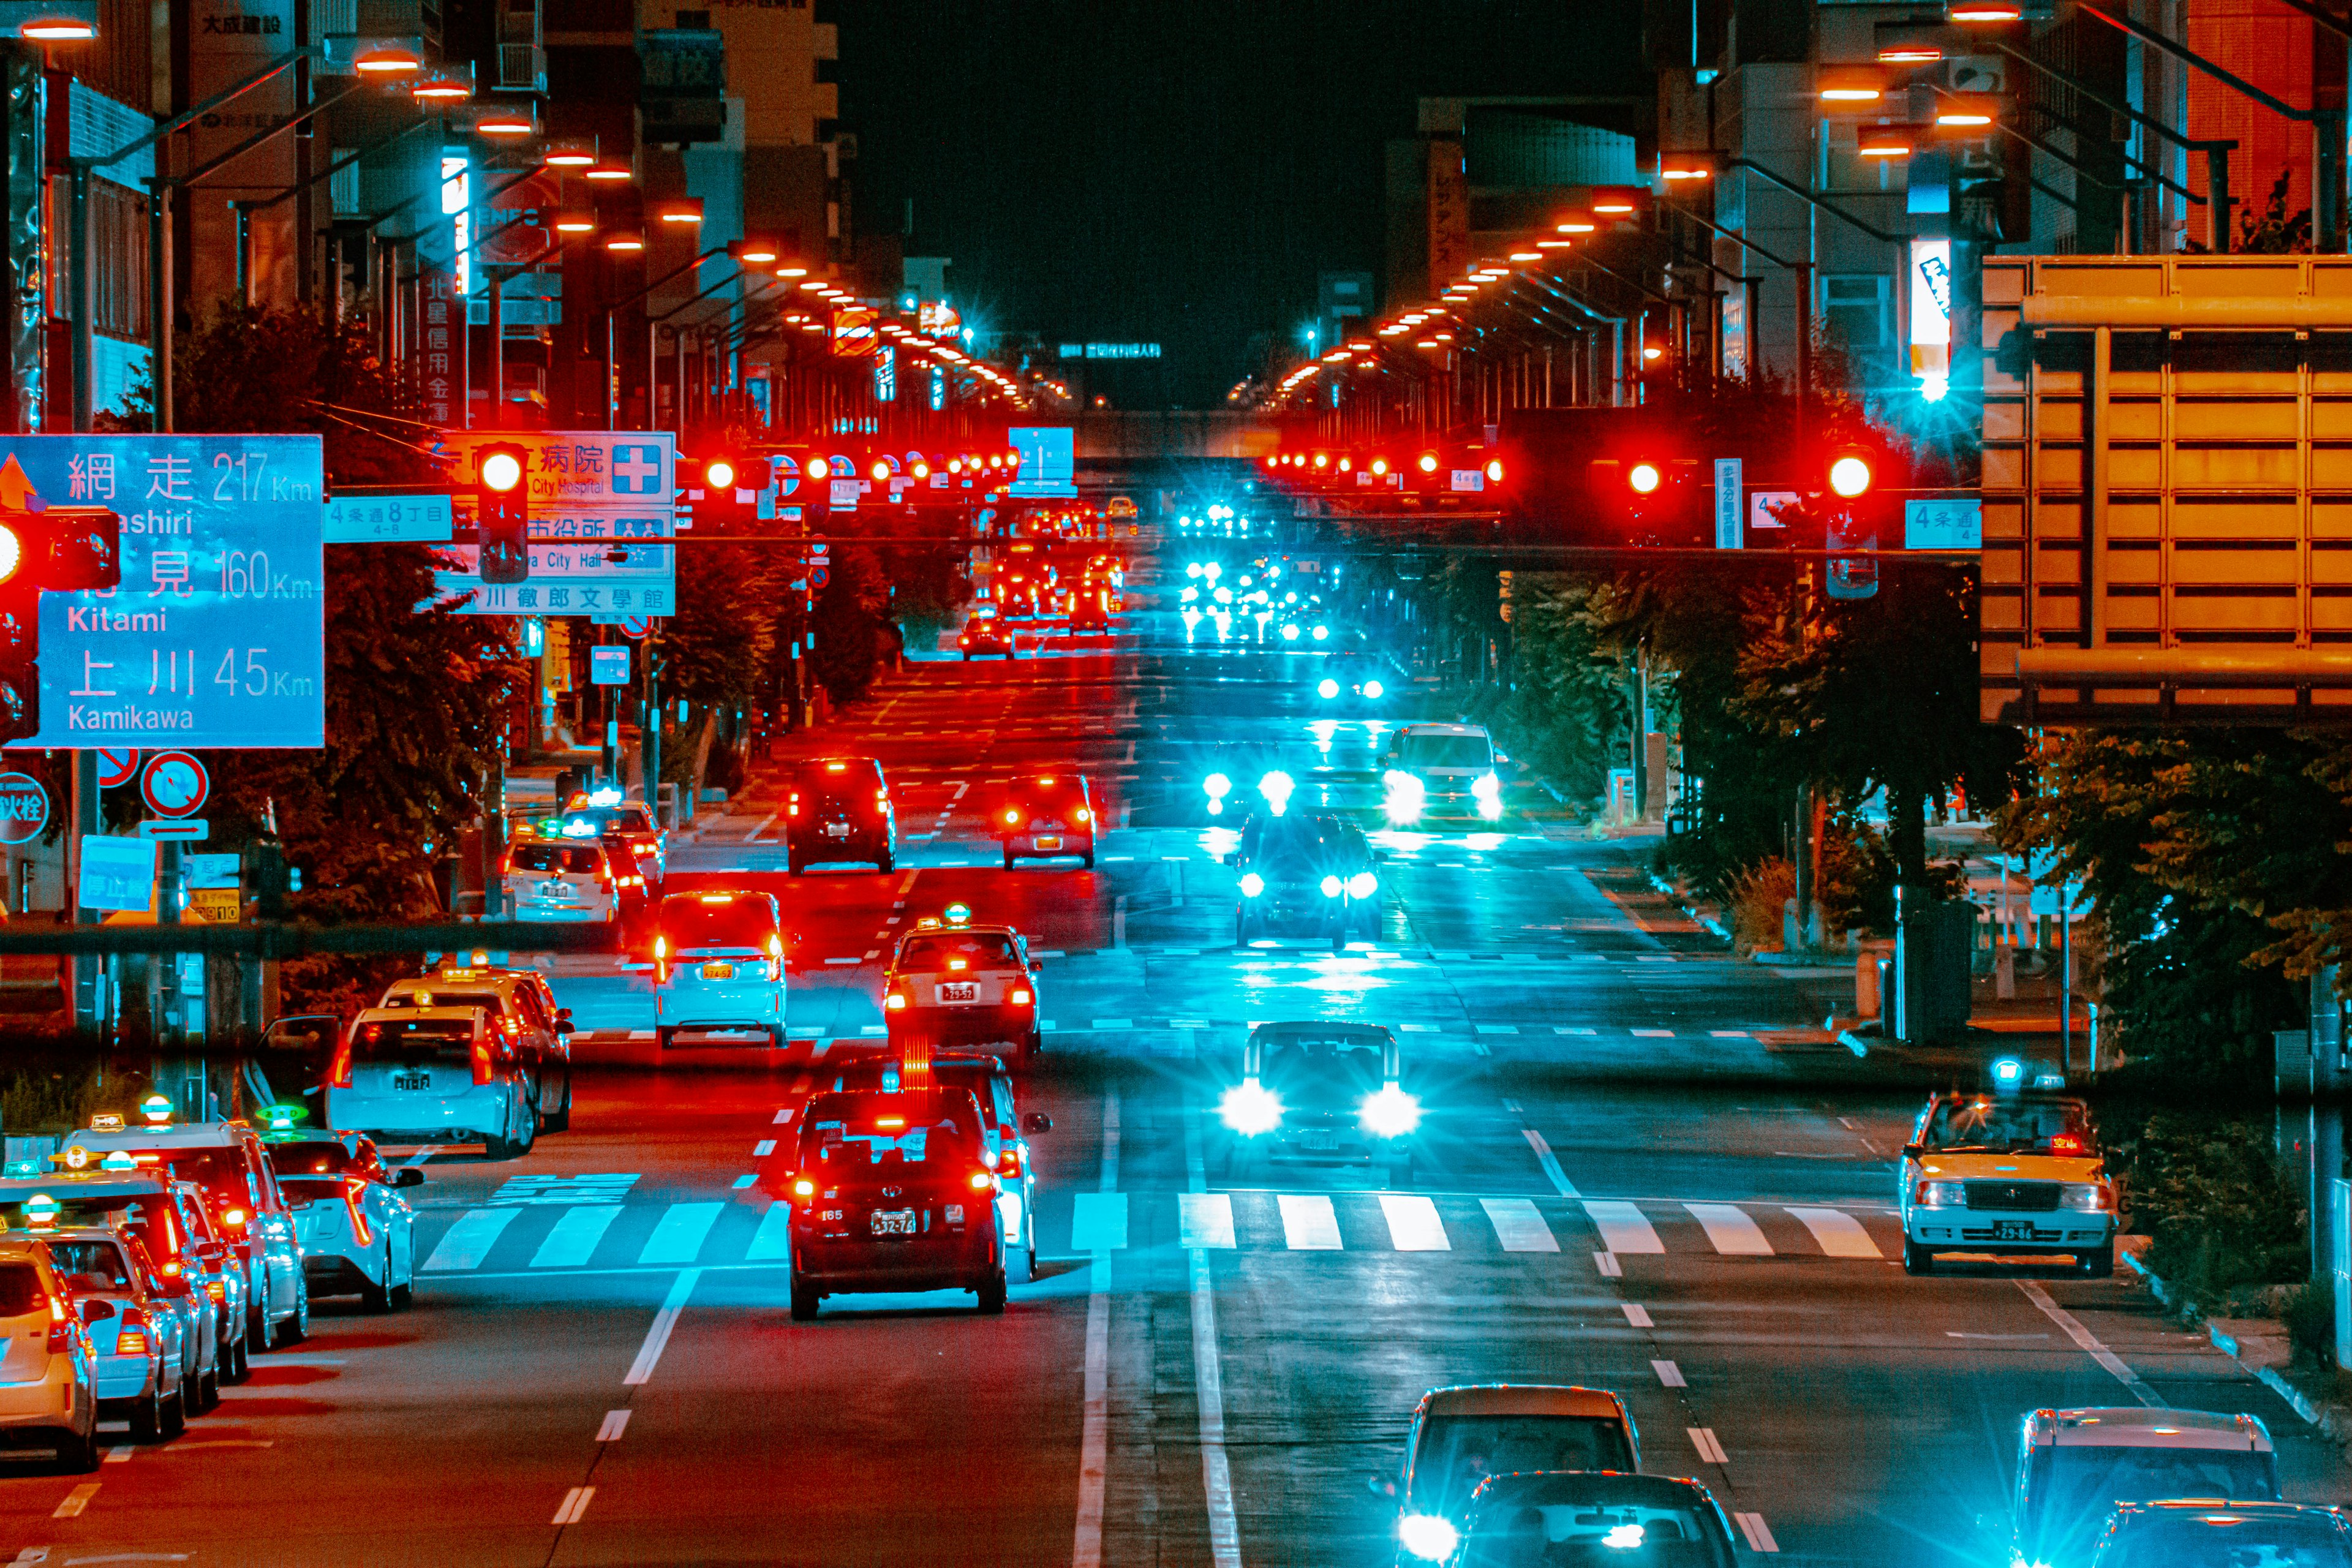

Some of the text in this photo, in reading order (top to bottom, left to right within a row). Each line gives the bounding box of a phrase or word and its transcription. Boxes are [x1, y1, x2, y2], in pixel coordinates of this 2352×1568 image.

[202, 15, 282, 35] 大成建設
[478, 208, 540, 227] ENEO
[426, 277, 449, 422] 北星信用金庫
[68, 453, 192, 502] 網走
[532, 478, 604, 497] City Hospital
[330, 501, 443, 525] 4条通8丁目
[1916, 506, 1973, 529] 4条通
[374, 524, 400, 535] 4-8
[548, 552, 570, 571] City
[579, 552, 602, 568] Hall
[67, 606, 167, 632] Kitami
[69, 649, 195, 697] 上川
[69, 704, 193, 730] Kamikawa
[86, 875, 147, 898] 停止線
[949, 990, 973, 1000] 29-52
[822, 1210, 843, 1221] 165
[881, 1219, 913, 1233] 32-76
[2001, 1227, 2032, 1239] 29-86
